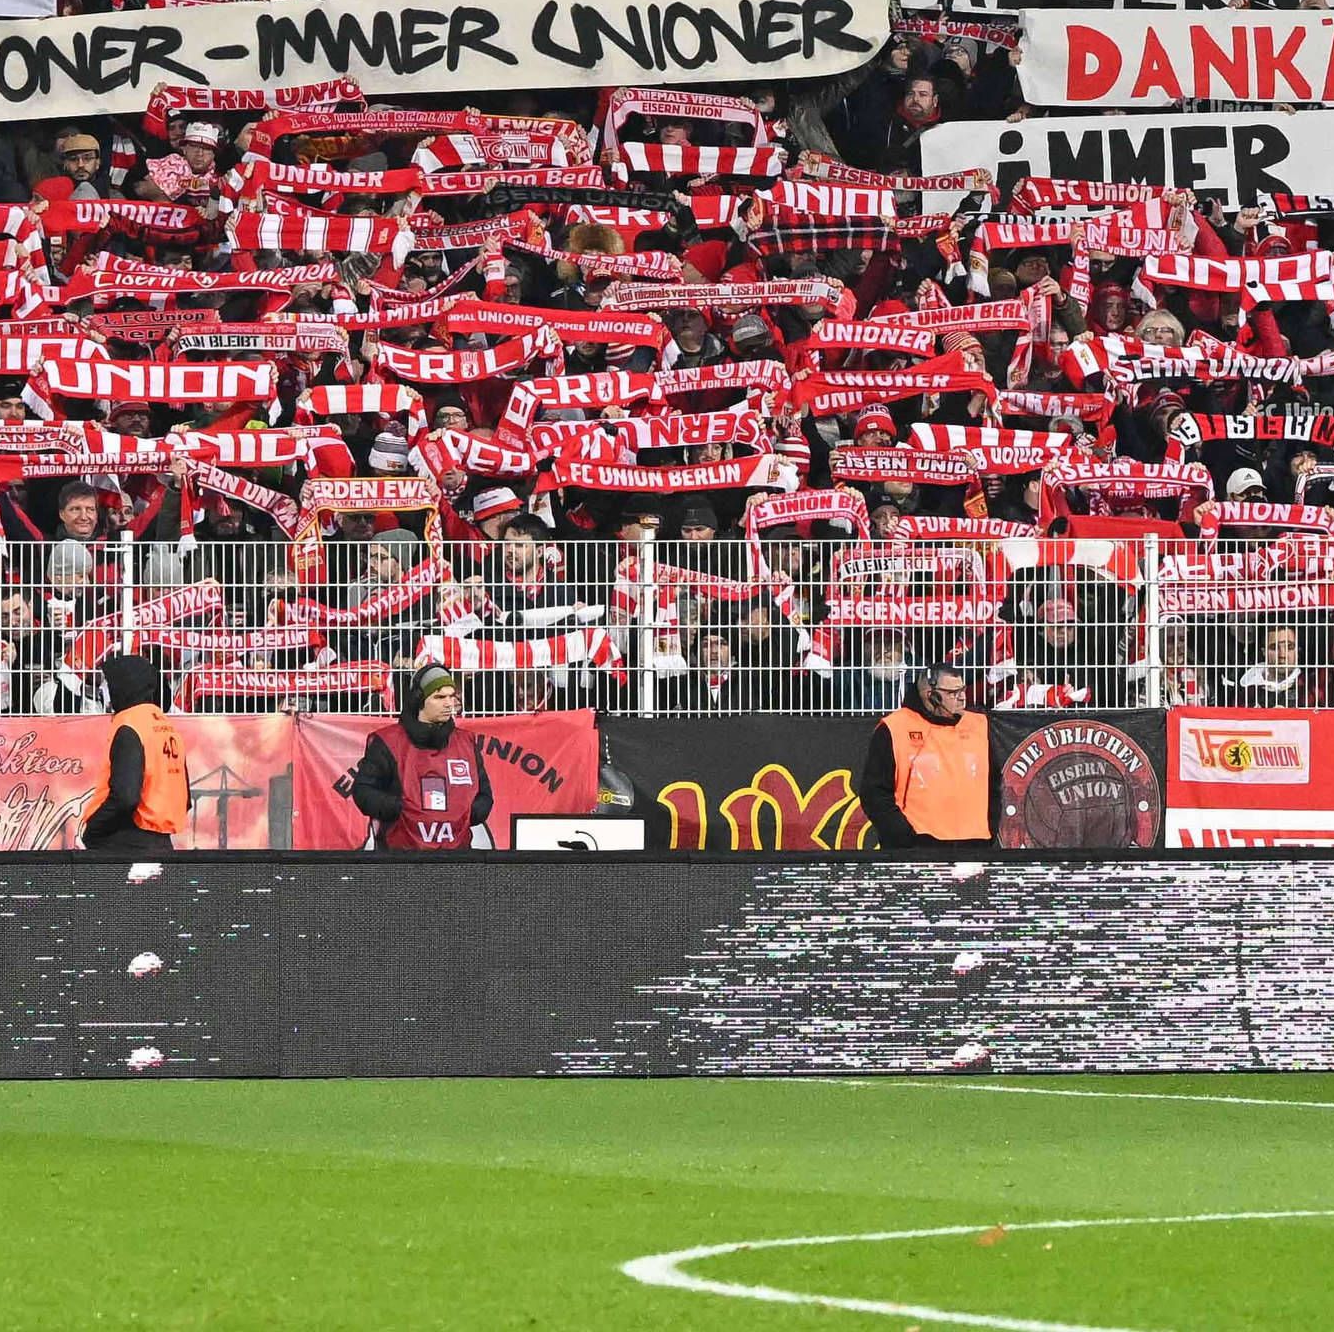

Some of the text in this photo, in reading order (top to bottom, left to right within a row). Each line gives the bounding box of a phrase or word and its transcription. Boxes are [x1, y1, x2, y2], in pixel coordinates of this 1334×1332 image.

[269, 168, 383, 188] UNIONER
[829, 169, 968, 190] EISERN UNION
[820, 321, 932, 350] UNIONER
[48, 363, 271, 399] UNION
[836, 452, 908, 473] EISERN
[570, 465, 741, 487] FC BERLIN
[1010, 726, 1143, 779] DIE ÜBLICHEN
[1252, 746, 1303, 768] UNION
[1047, 763, 1109, 788] EISERN
[1058, 780, 1123, 806] UNION
[417, 822, 455, 843] VA
